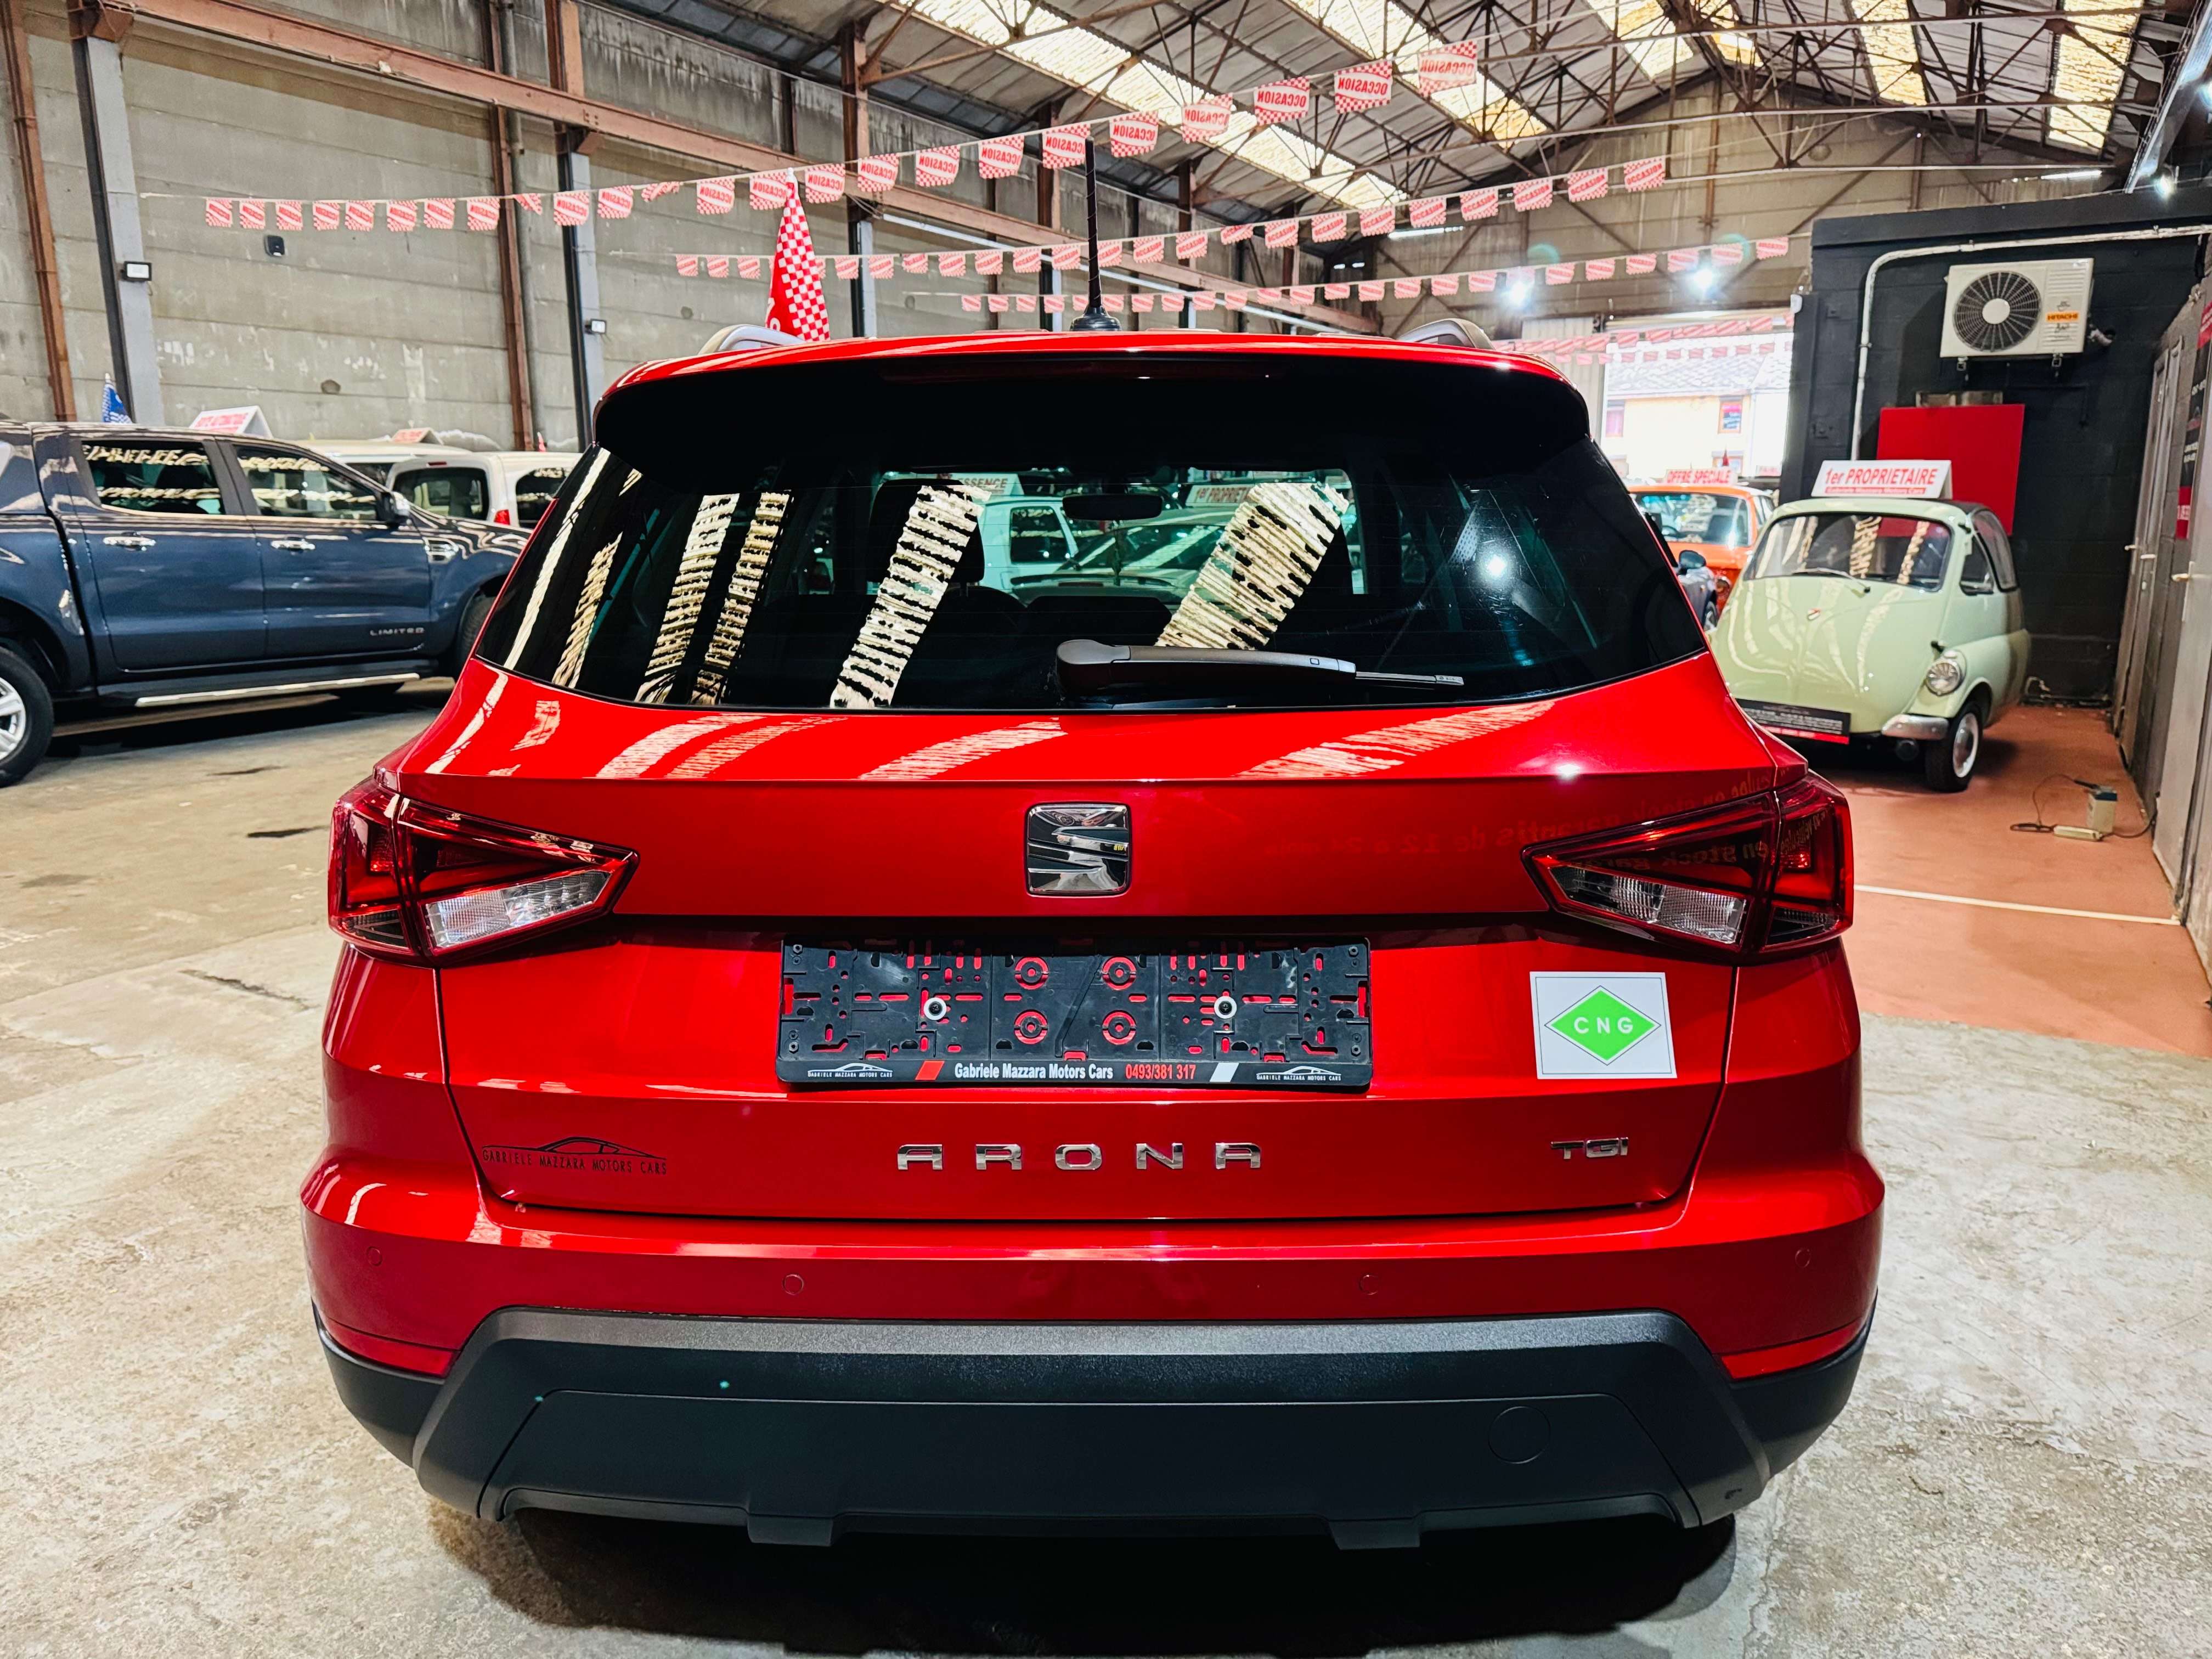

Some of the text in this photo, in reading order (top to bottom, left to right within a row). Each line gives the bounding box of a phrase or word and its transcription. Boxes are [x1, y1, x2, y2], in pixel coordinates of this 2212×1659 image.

[1627, 163, 1662, 185] OCCASION
[2047, 312, 2078, 321] HITACHI
[958, 478, 1008, 489] SSENCE
[1666, 469, 1731, 484] OFFRE SPECIALE
[1825, 467, 1938, 485] 1er PROPRIETAIRE
[370, 627, 425, 636] LIMITED
[1573, 1017, 1633, 1034] CNG
[955, 1062, 1196, 1080] Gabriele Mazzara Motors Cars 0493/381 317
[482, 1149, 667, 1176] GABRIELE MAZZARA MOTORS CARS
[897, 1143, 1261, 1170] ARONA
